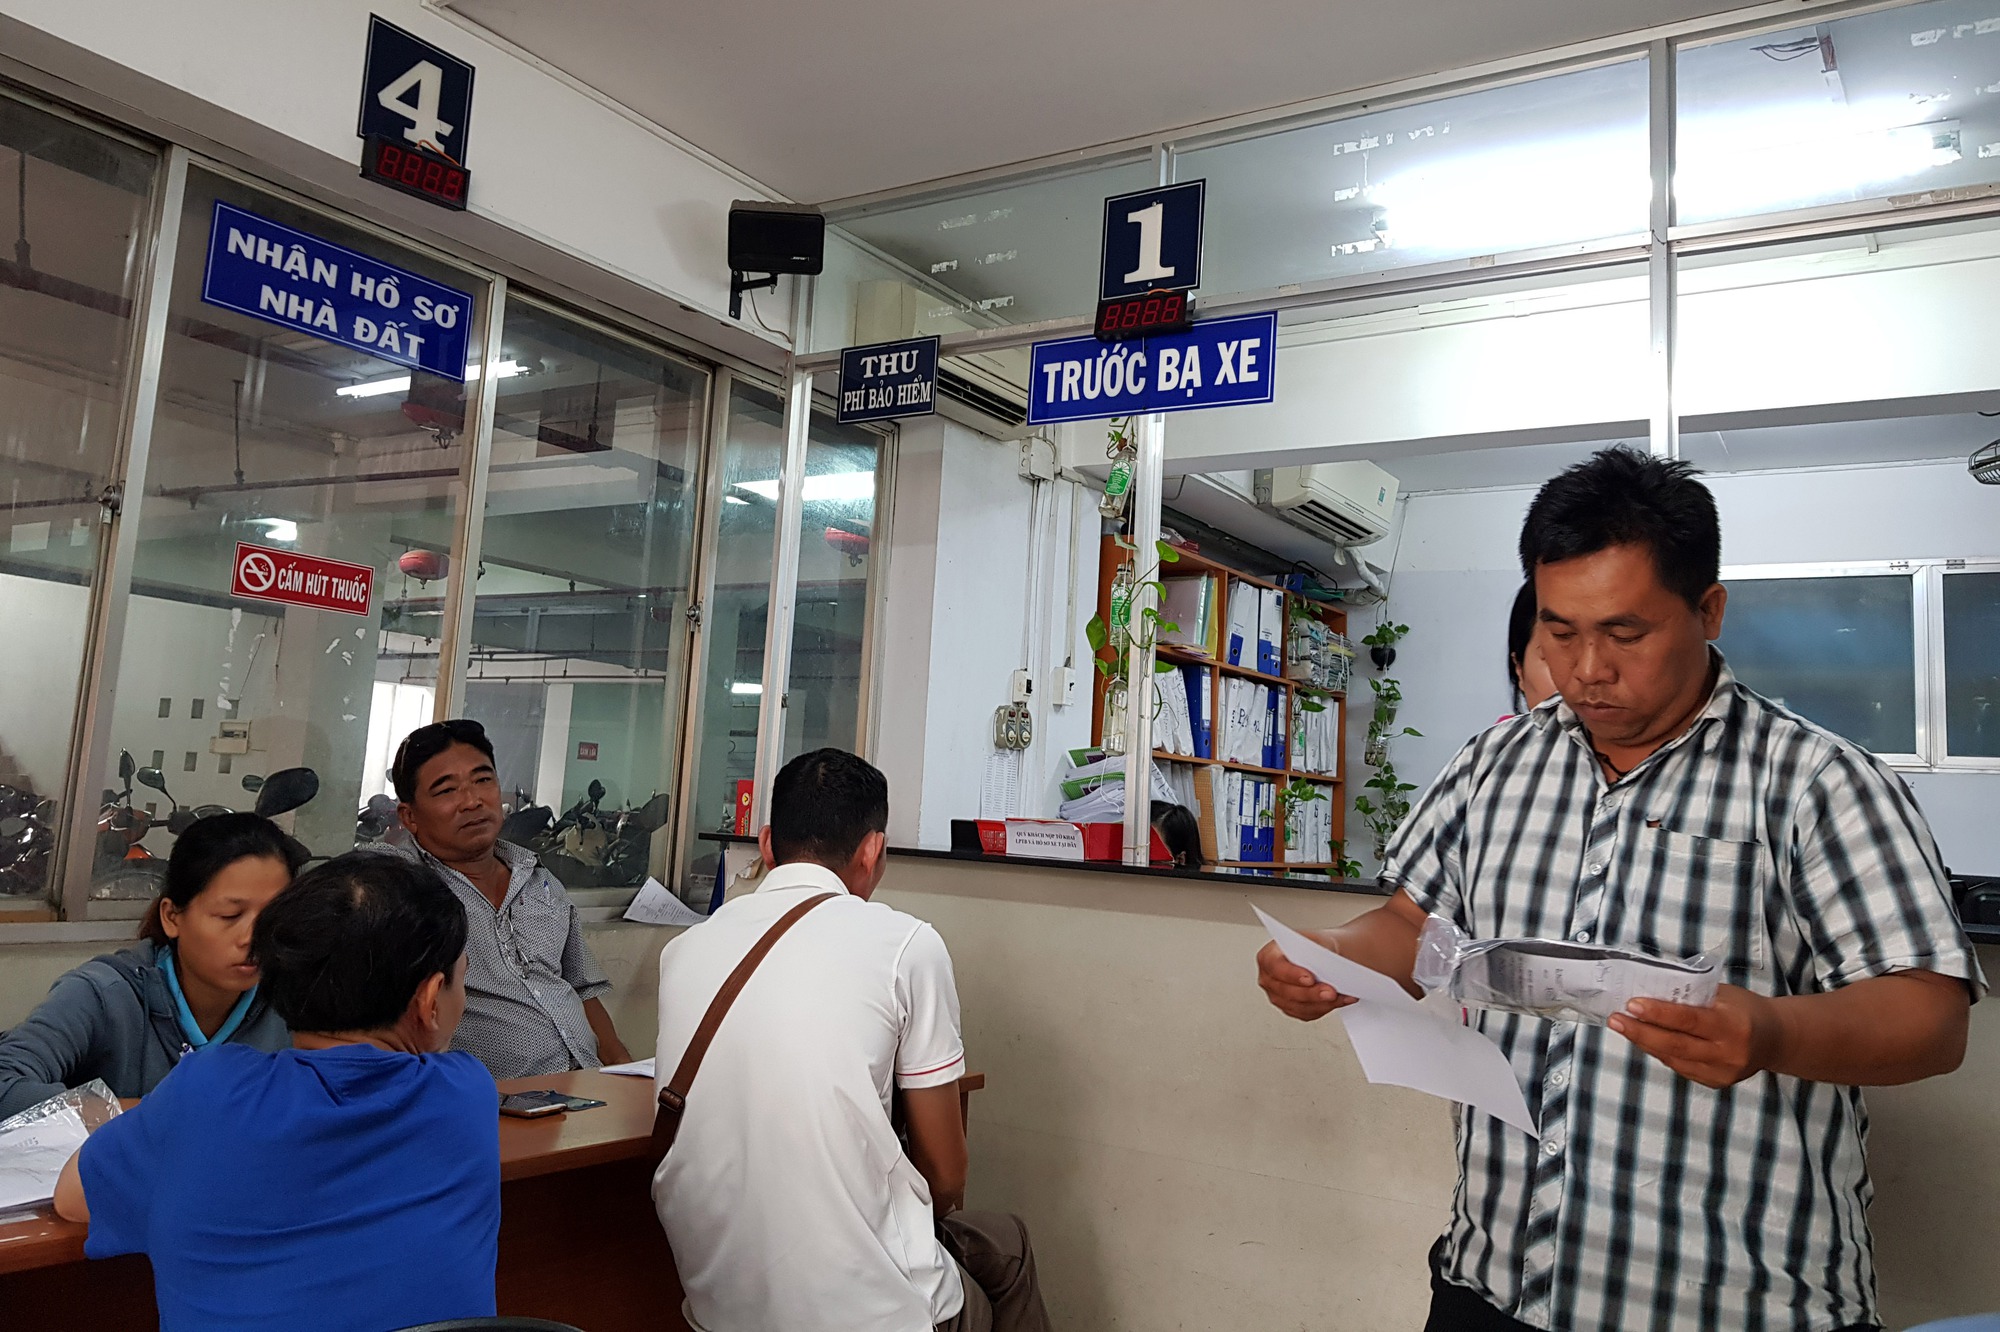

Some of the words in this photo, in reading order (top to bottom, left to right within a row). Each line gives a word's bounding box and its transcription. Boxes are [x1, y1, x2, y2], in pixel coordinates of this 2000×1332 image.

[377, 59, 454, 153] 4
[227, 227, 338, 289] NHẬN
[350, 275, 400, 309] HỒ
[412, 295, 460, 329] SƠ
[1124, 203, 1175, 284] 1
[259, 284, 338, 334] NHÀ
[352, 315, 425, 359] ĐẤT
[843, 383, 866, 412] PHÍ
[868, 379, 893, 409] BẢO
[897, 374, 932, 406] HIỂM
[860, 350, 919, 378] THU
[1043, 343, 1147, 404] TRƯỚC
[1157, 345, 1202, 398] BẠ
[1214, 338, 1261, 386] XE
[277, 562, 304, 593] CẤM
[305, 569, 329, 597] HÚT
[331, 574, 367, 603] THUỐC
